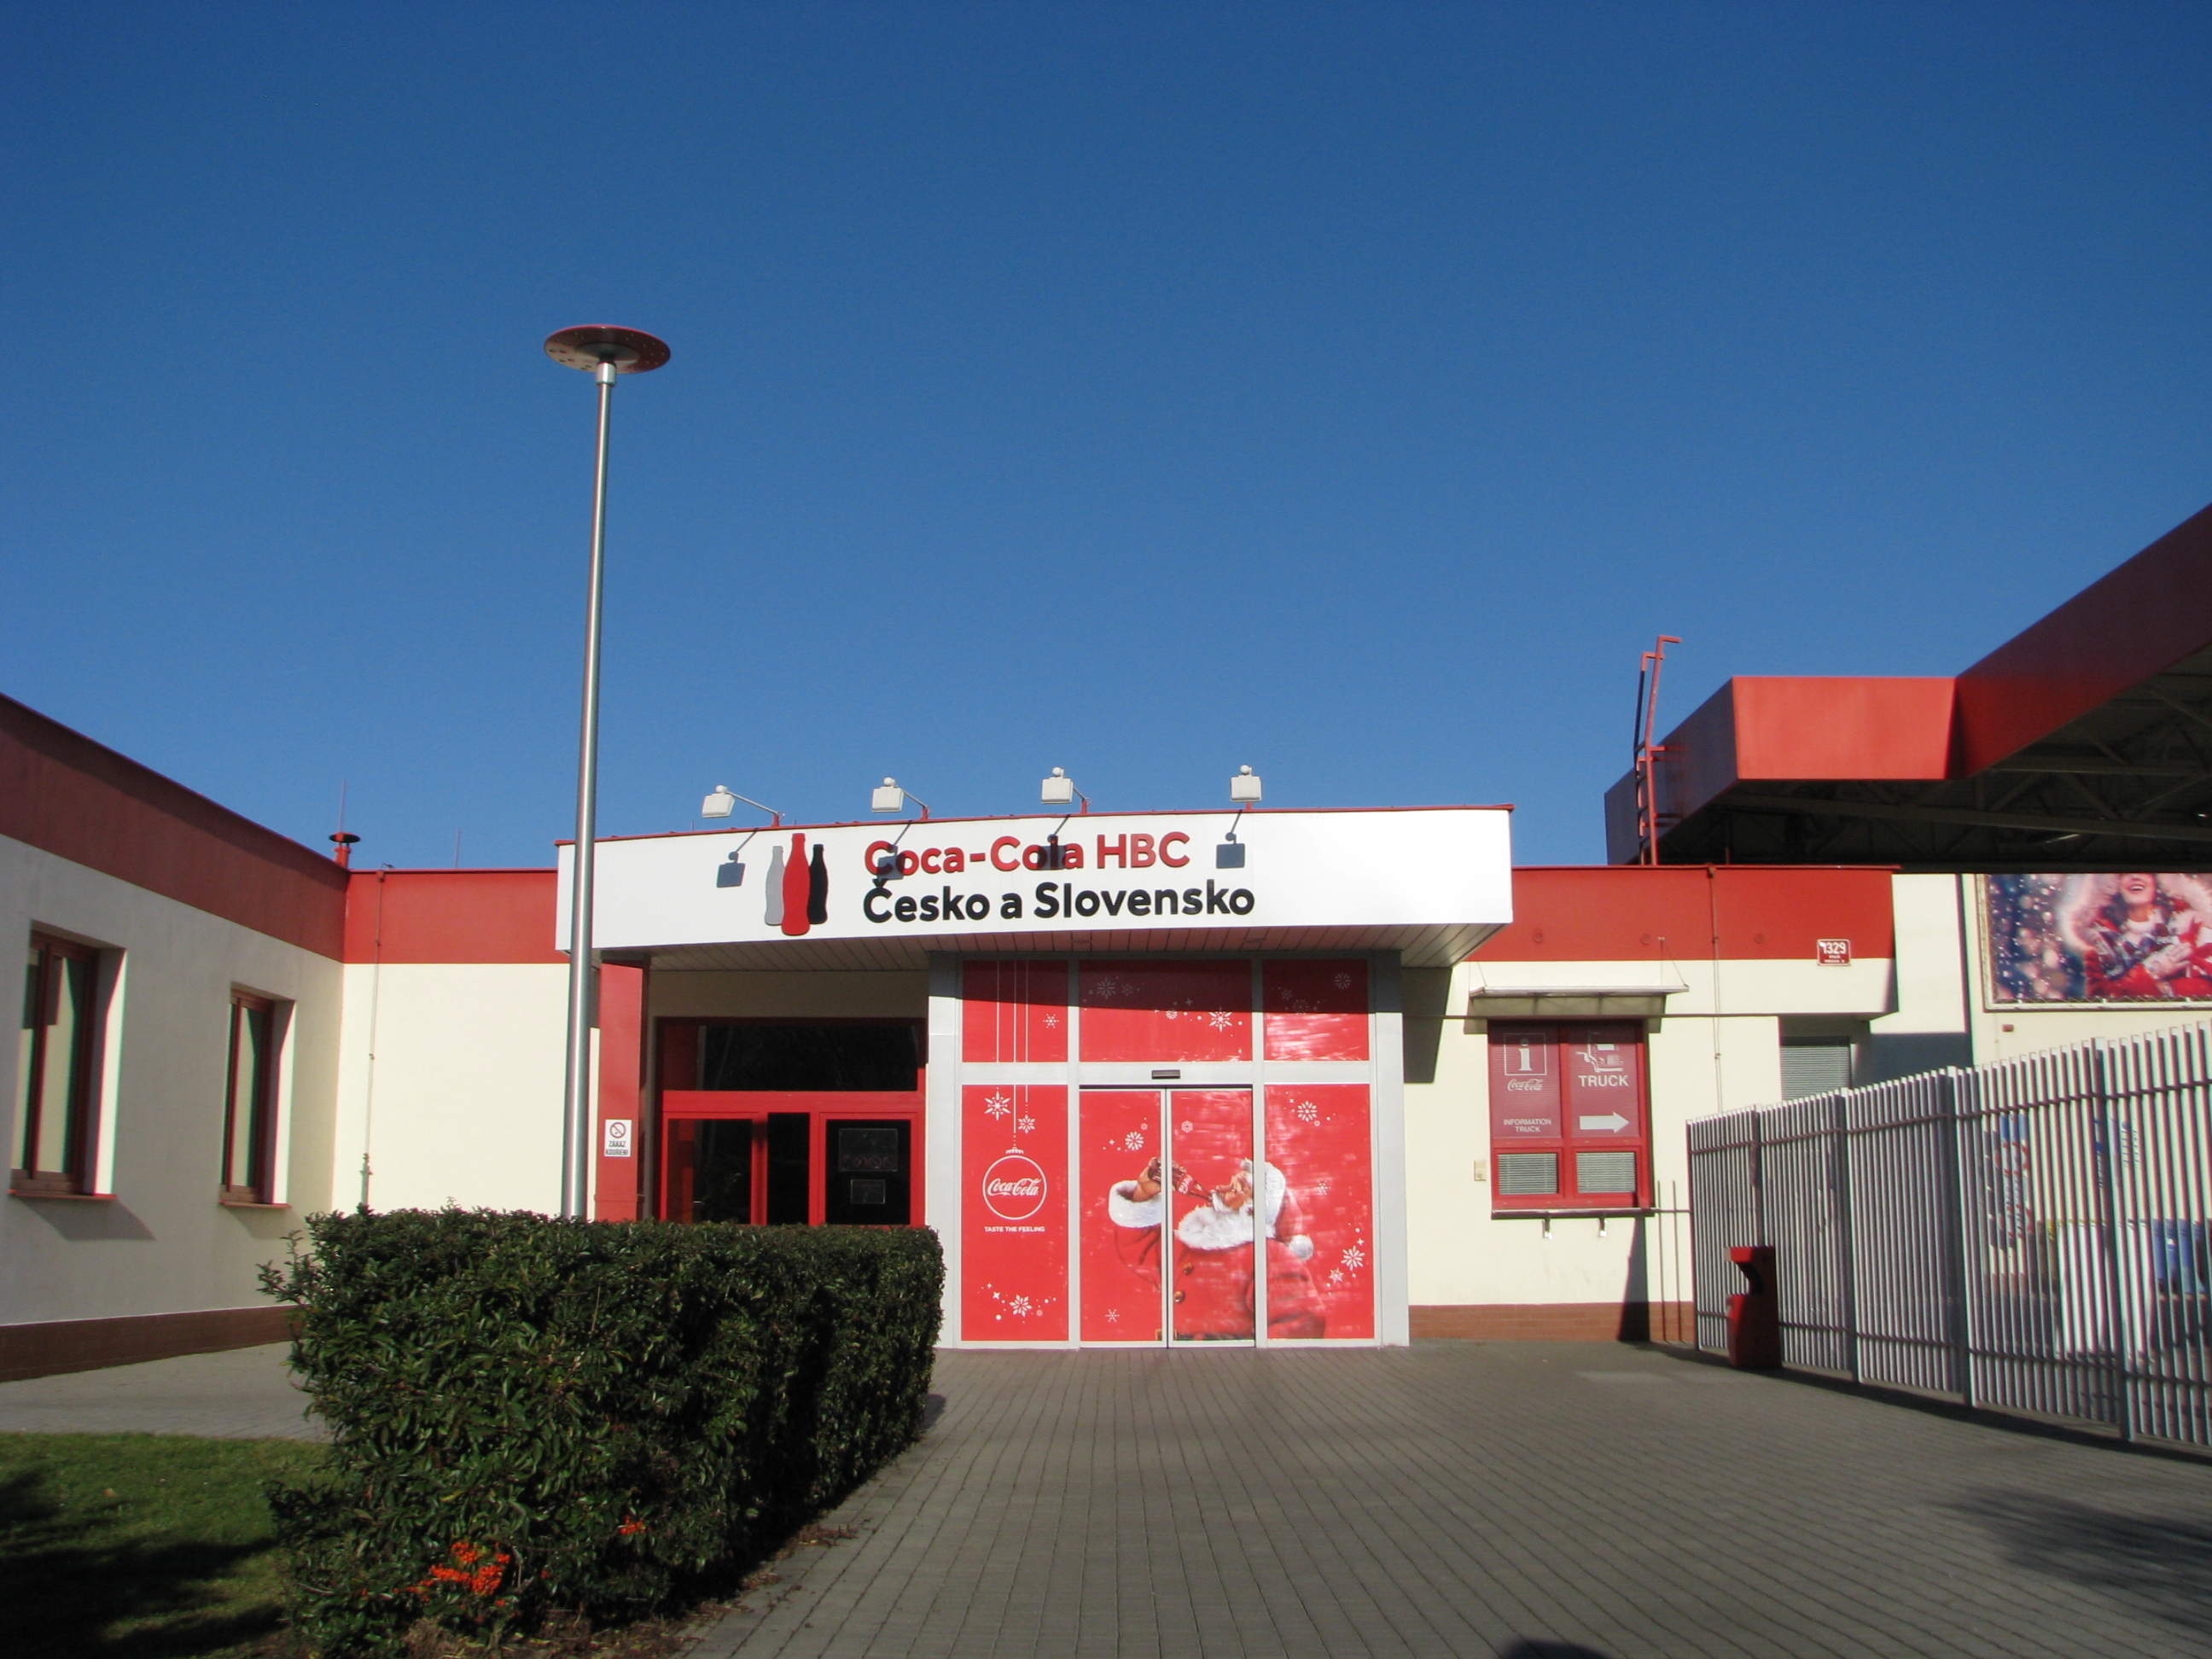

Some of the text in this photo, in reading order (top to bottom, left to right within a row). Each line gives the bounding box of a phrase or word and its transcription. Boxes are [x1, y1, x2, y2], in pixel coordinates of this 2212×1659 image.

[864, 831, 1190, 876] Coca-Cola HBC
[863, 878, 1255, 923] Česko a Slovensko
[1820, 941, 1847, 954] 1329
[1578, 1074, 1629, 1087] TRUCK
